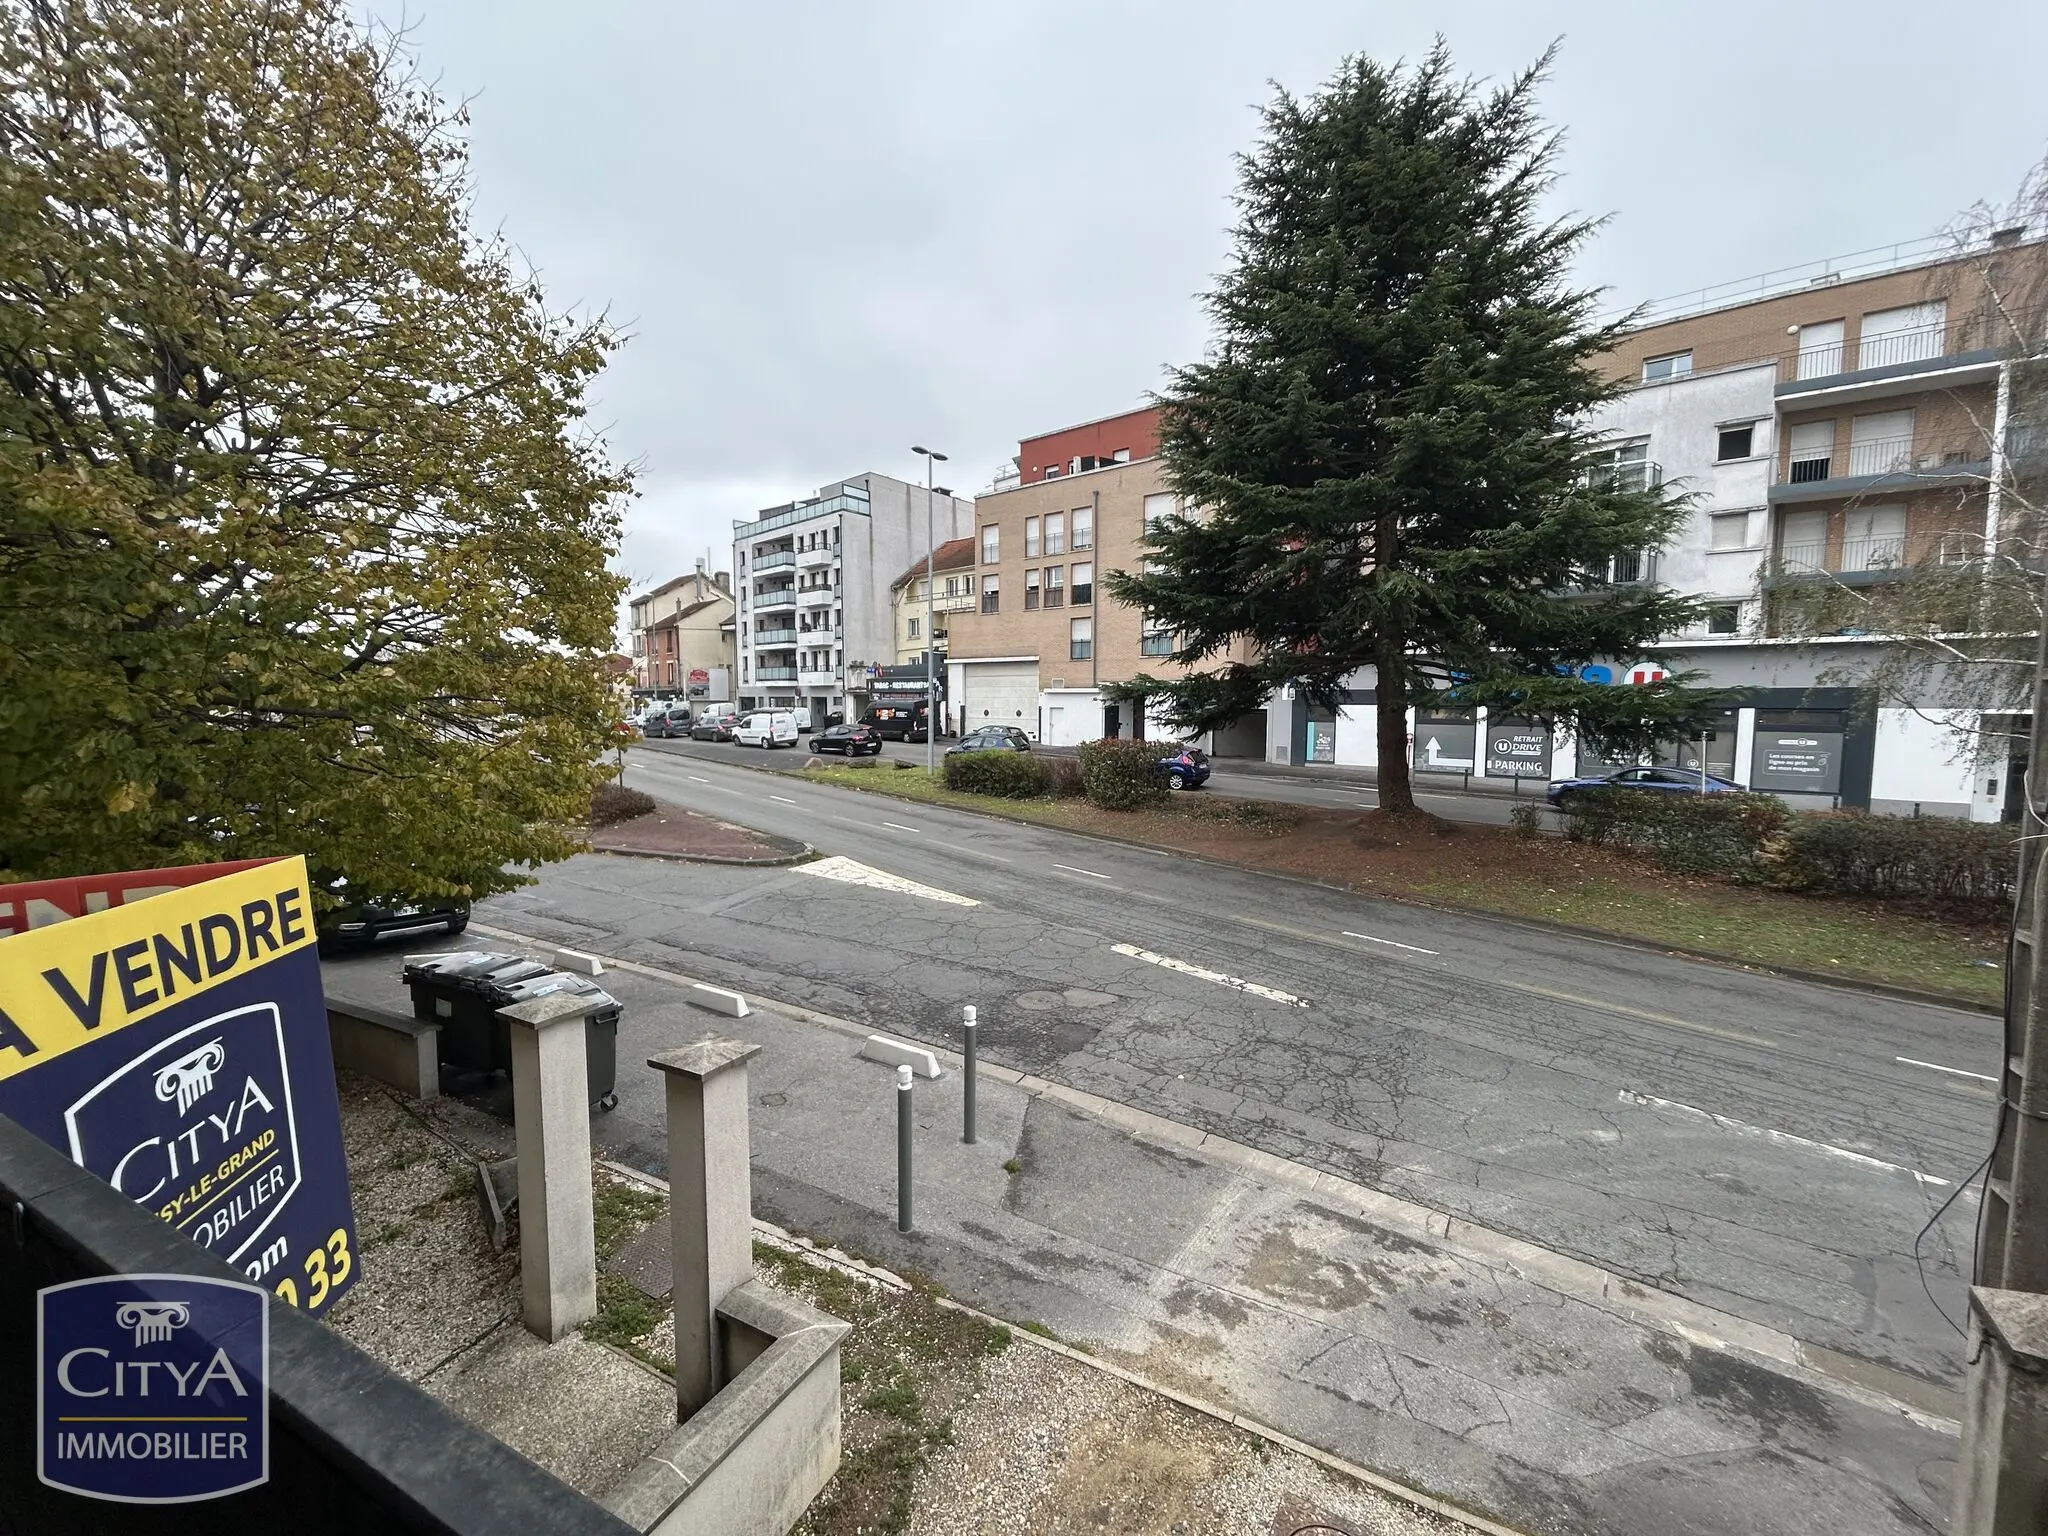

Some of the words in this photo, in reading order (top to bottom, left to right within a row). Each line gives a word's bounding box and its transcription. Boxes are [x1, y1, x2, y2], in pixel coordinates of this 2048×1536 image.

[892, 681, 923, 689] RESTAURANT
[1512, 743, 1543, 751] DRIVE
[1513, 735, 1543, 743] RETRAIT
[1495, 760, 1542, 771] PARKING
[42, 887, 306, 1031] VENDRE
[110, 1075, 275, 1204] CITYA
[155, 1128, 275, 1223] SY-LE-GRAND
[304, 1228, 352, 1309] 33
